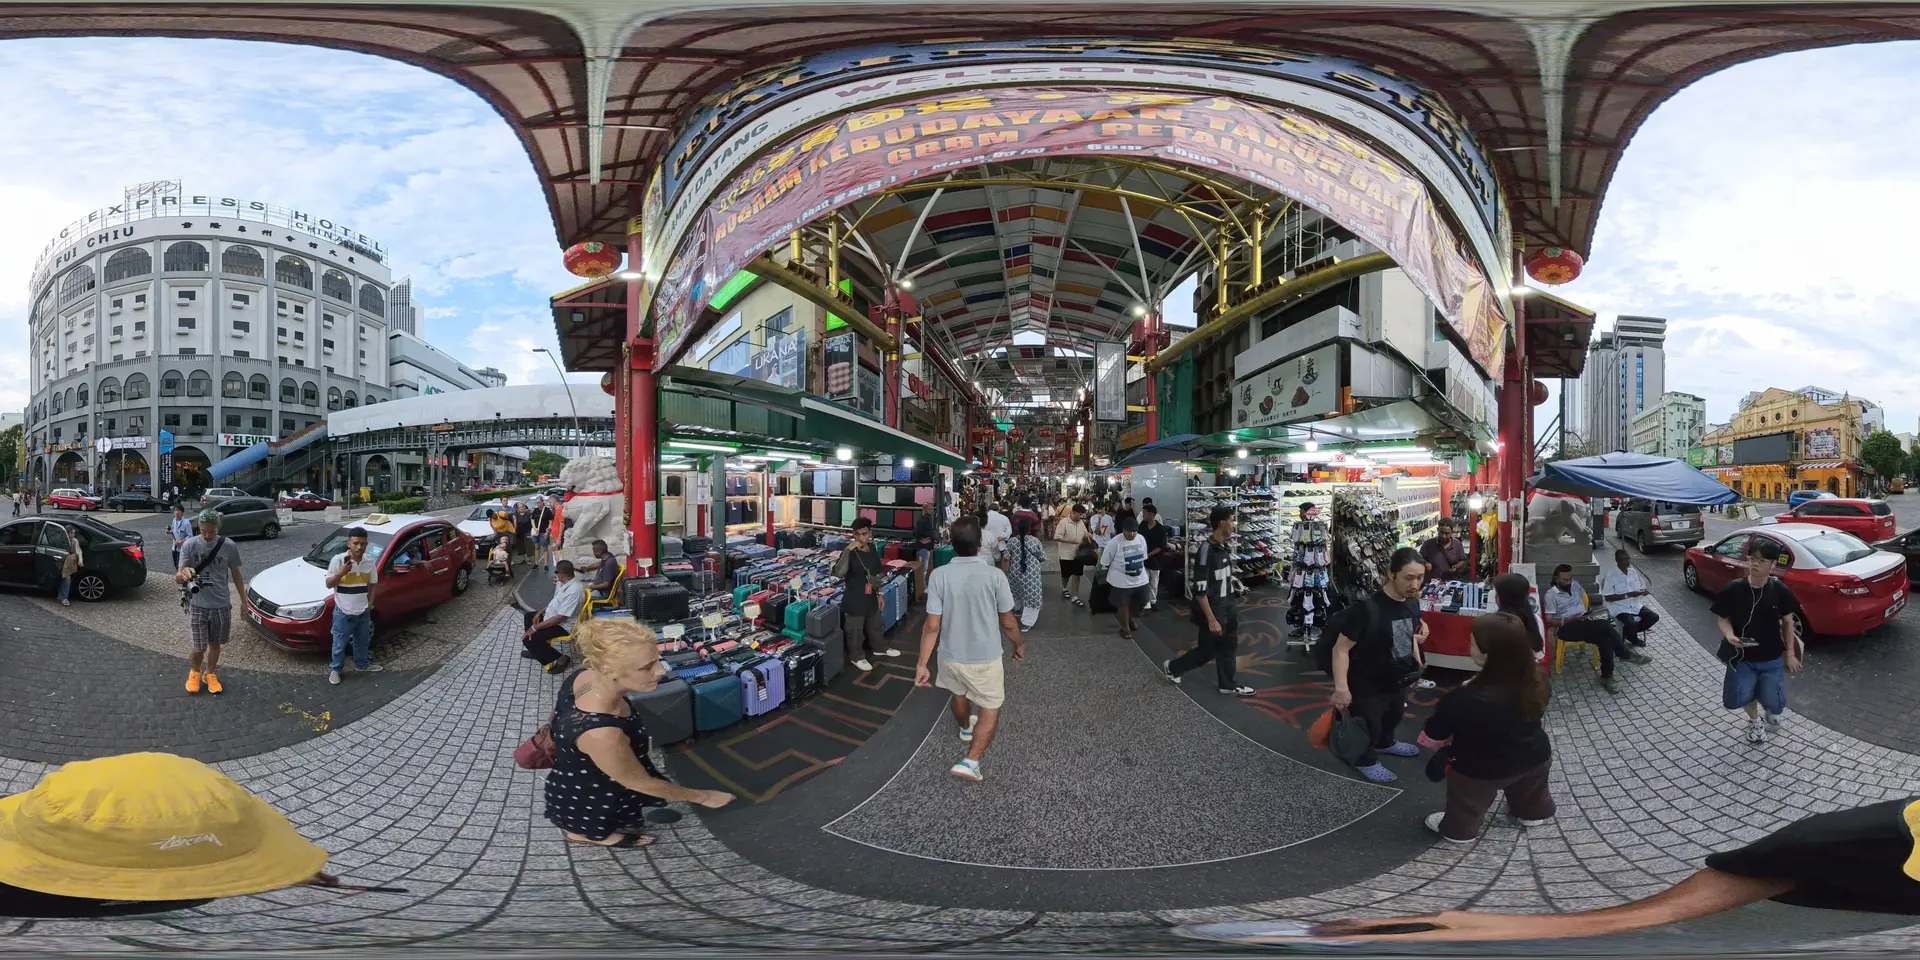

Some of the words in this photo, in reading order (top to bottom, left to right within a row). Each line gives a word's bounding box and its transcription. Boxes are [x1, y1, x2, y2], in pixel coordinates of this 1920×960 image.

[693, 121, 770, 194] DATANG
[835, 66, 1257, 98] WELCOME
[710, 166, 802, 250] ROGRAM
[809, 108, 1184, 176] KEBUDAYAAN
[886, 129, 1019, 165] GBBM
[1100, 122, 1298, 178] PETALING
[1302, 168, 1386, 221] STREET
[1328, 69, 1490, 205] STREET
[1333, 101, 1456, 198] 欢迎光临
[56, 247, 77, 268] FUI
[87, 225, 134, 248] CHIU
[88, 195, 265, 223] EXPRESS
[294, 210, 383, 253] HOTEL
[754, 341, 799, 371] UKANA
